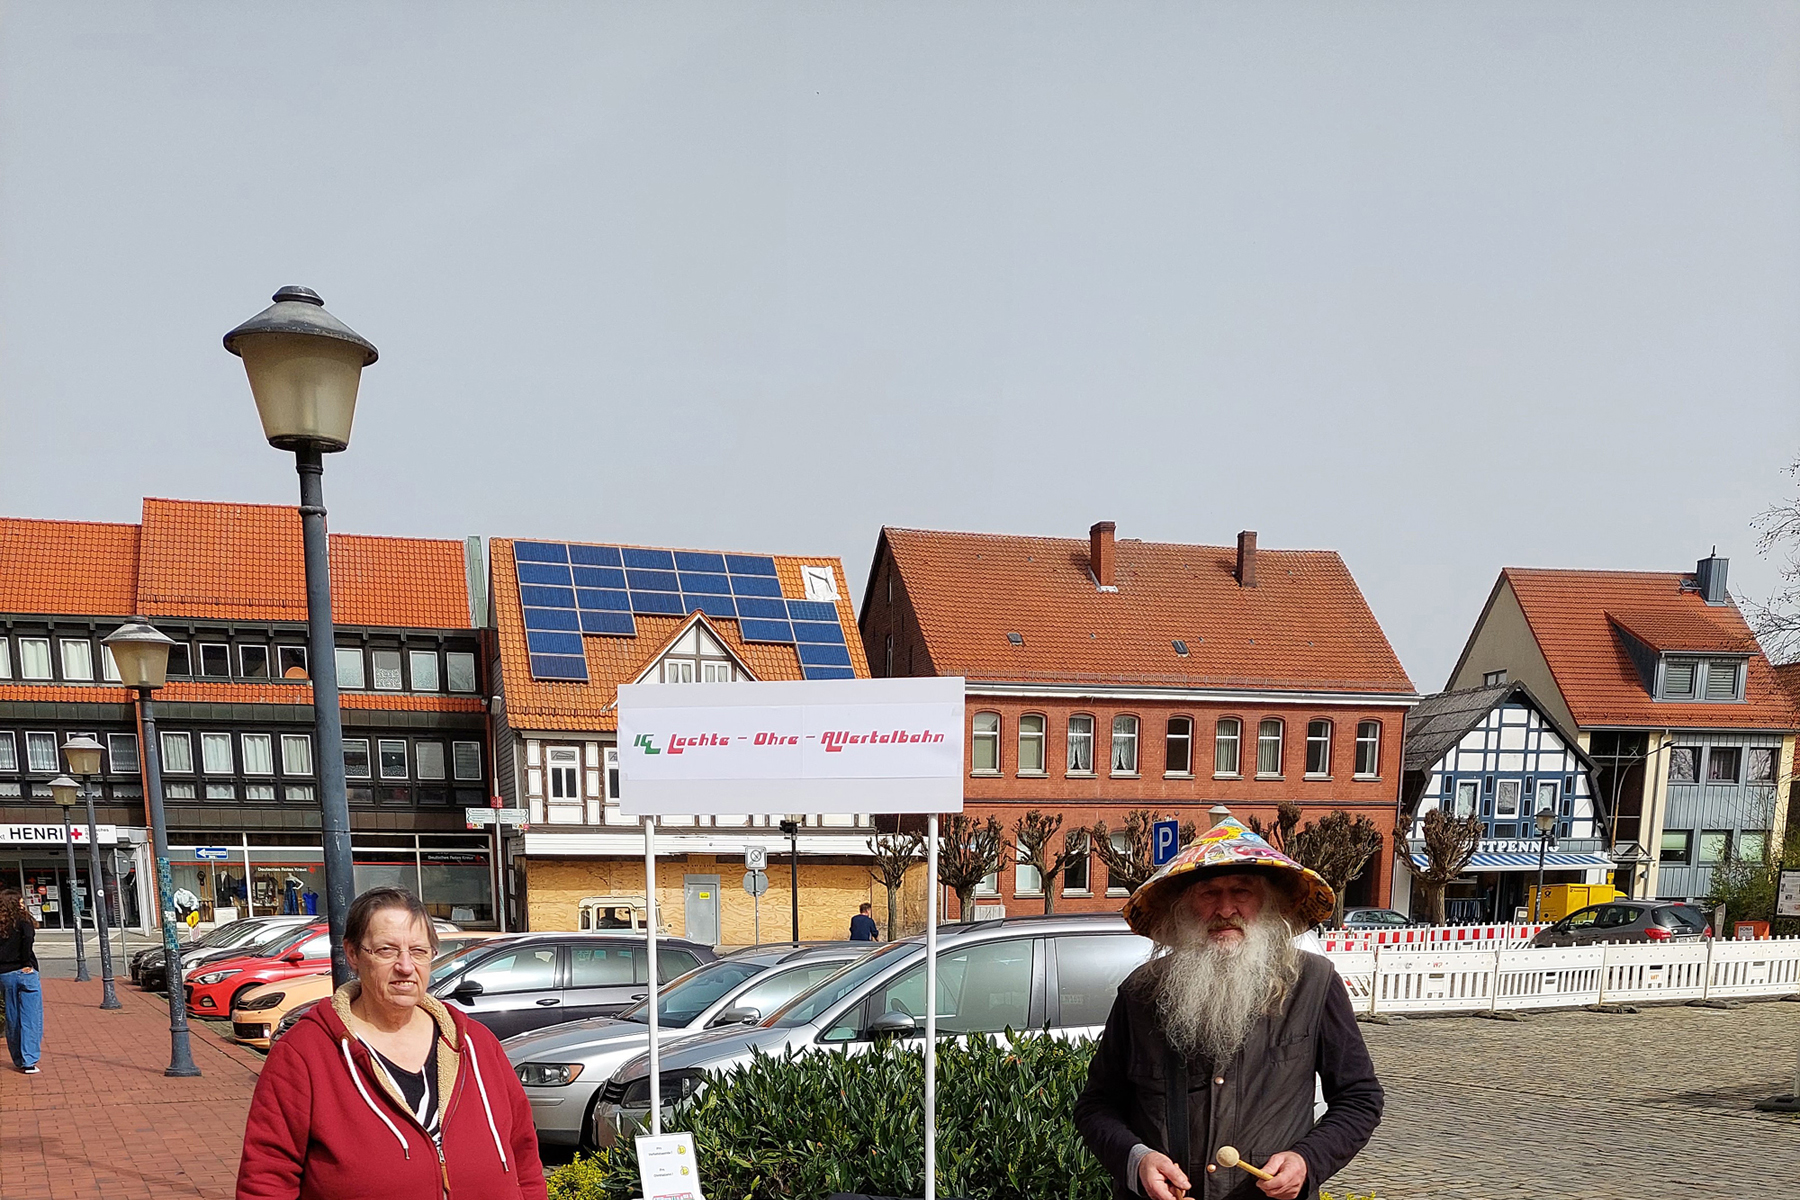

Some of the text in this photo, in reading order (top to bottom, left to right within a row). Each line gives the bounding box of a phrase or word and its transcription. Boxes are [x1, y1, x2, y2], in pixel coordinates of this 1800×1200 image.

[667, 733, 730, 755] Lachte
[753, 732, 798, 746] Ohre
[820, 730, 945, 753] Allertalbahn
[9, 827, 64, 840] HENRI
[1158, 827, 1173, 861] P
